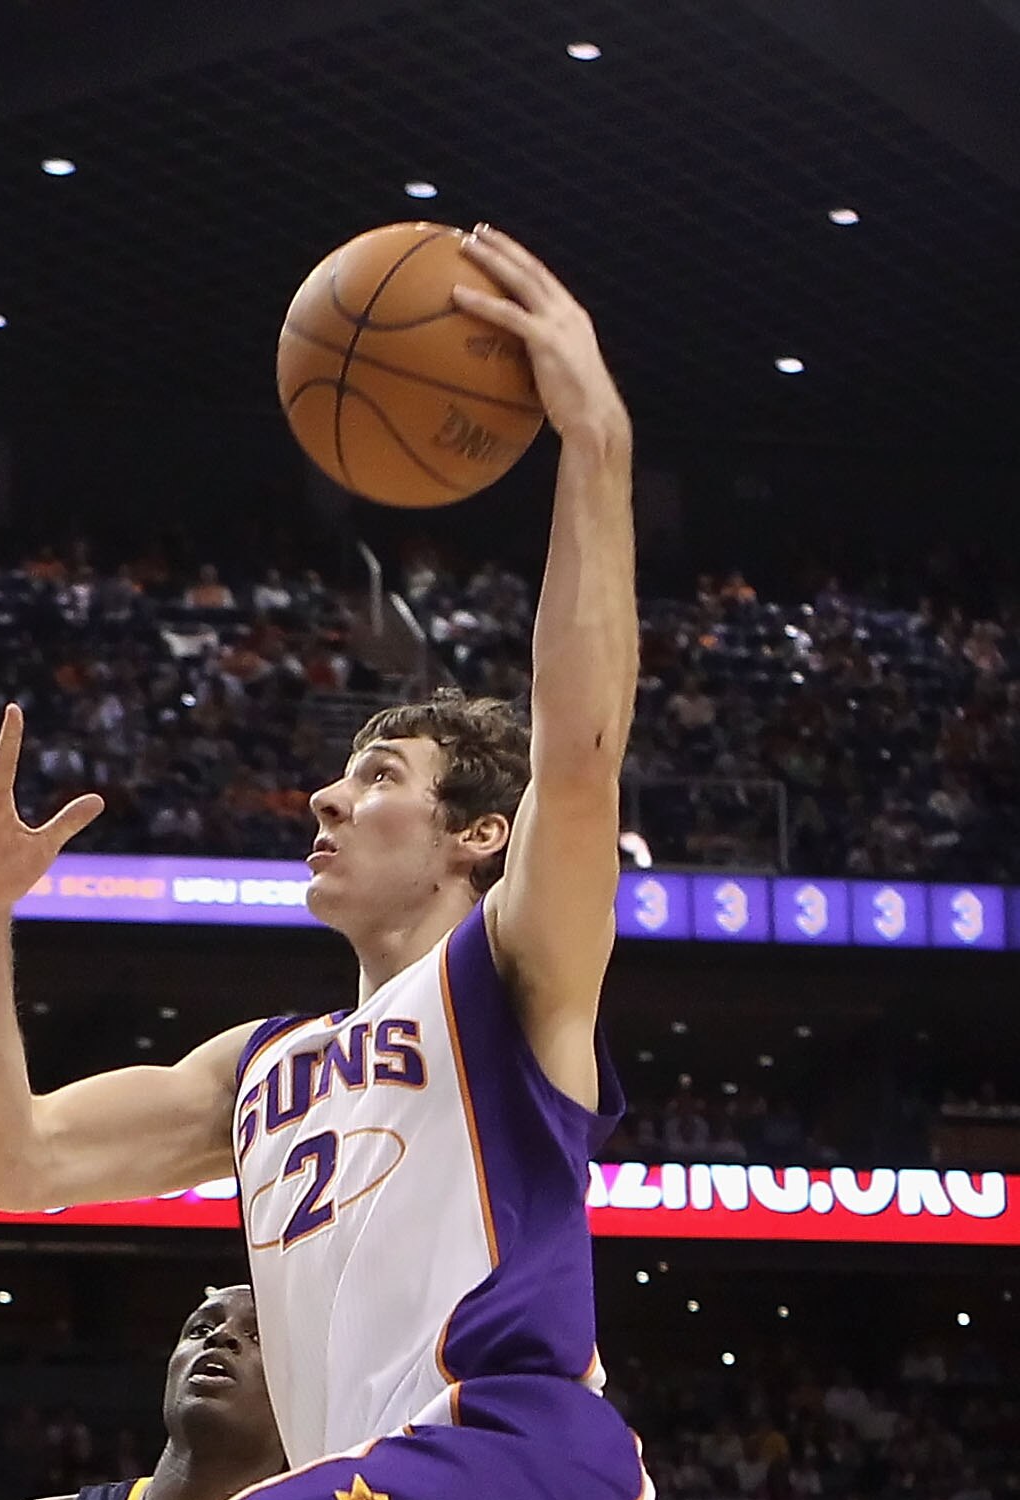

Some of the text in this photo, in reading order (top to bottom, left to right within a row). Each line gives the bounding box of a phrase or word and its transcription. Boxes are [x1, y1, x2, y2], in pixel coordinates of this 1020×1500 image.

[635, 879, 984, 943] 3 3 3 3 3
[237, 1017, 429, 1166] SUNS
[282, 1130, 340, 1251] 2
